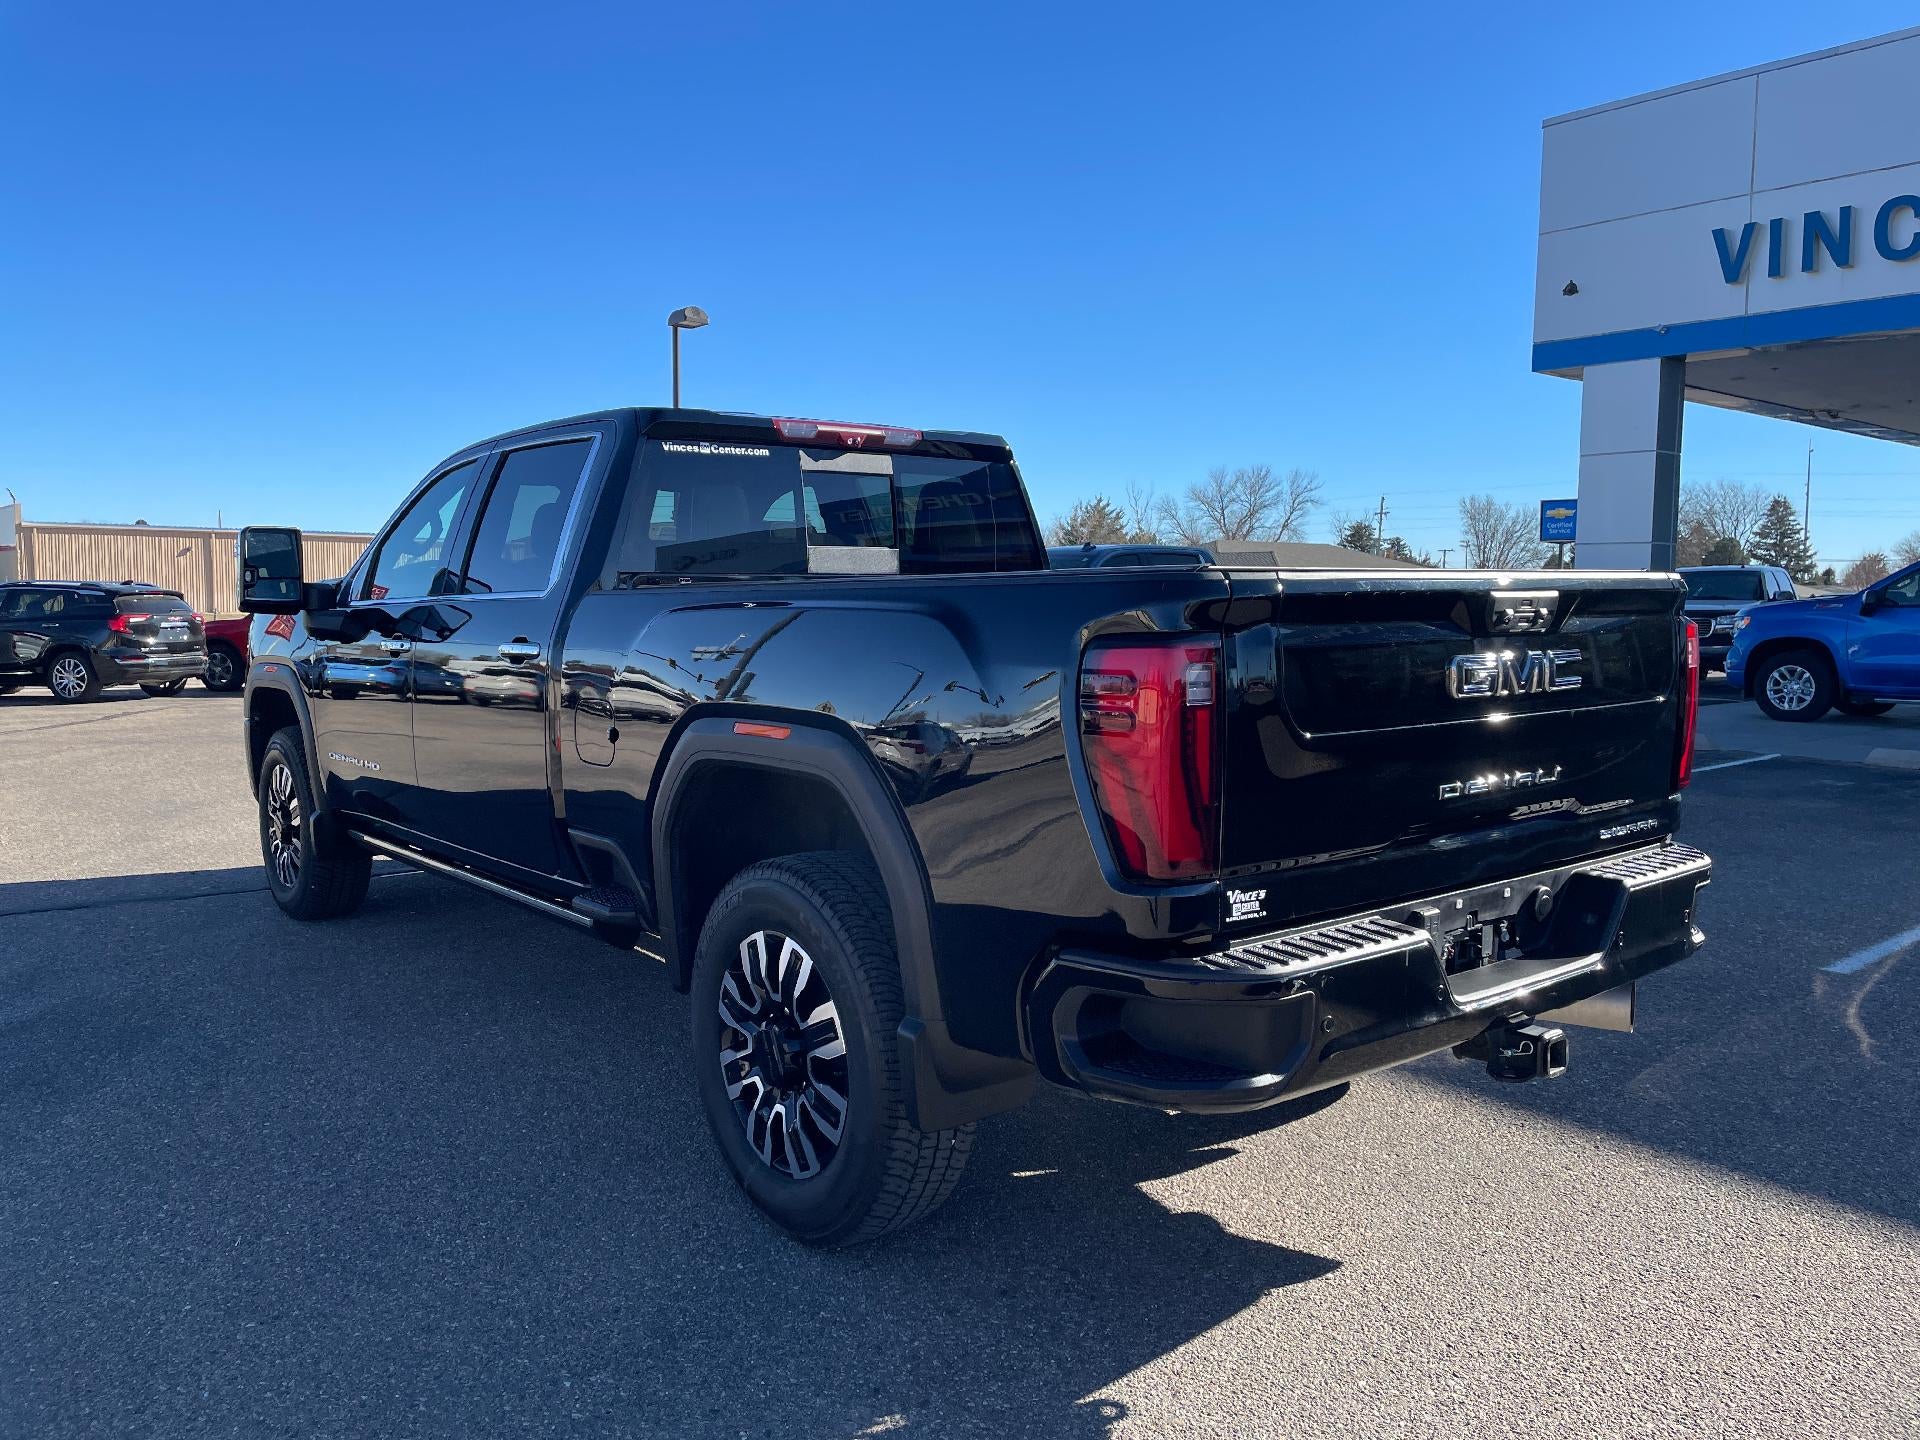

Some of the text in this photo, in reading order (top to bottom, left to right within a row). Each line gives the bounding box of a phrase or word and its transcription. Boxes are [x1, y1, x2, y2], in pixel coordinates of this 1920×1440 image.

[1711, 194, 1920, 285] VINC
[1546, 521, 1573, 530] Certified
[1445, 648, 1583, 699] GMC
[328, 752, 381, 771] DENALI HD
[1438, 765, 1562, 800] DENALI
